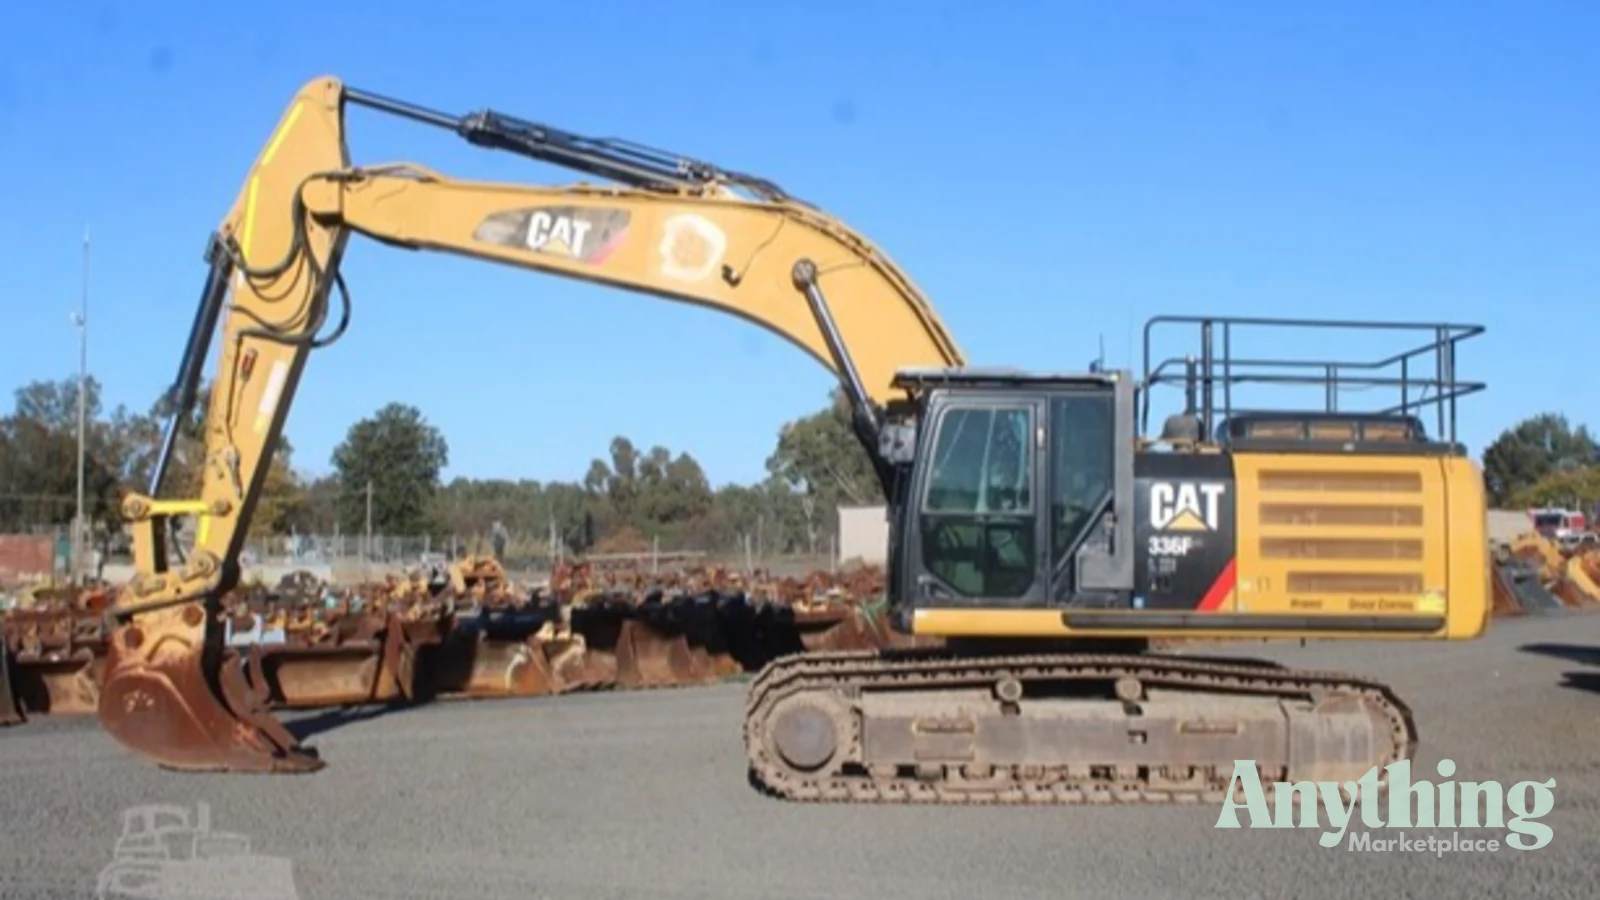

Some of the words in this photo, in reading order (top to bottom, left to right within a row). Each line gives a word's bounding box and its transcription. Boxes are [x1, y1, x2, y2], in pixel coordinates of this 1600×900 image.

[526, 211, 592, 258] CAT
[1150, 482, 1226, 532] CAT
[1148, 535, 1193, 556] 336F
